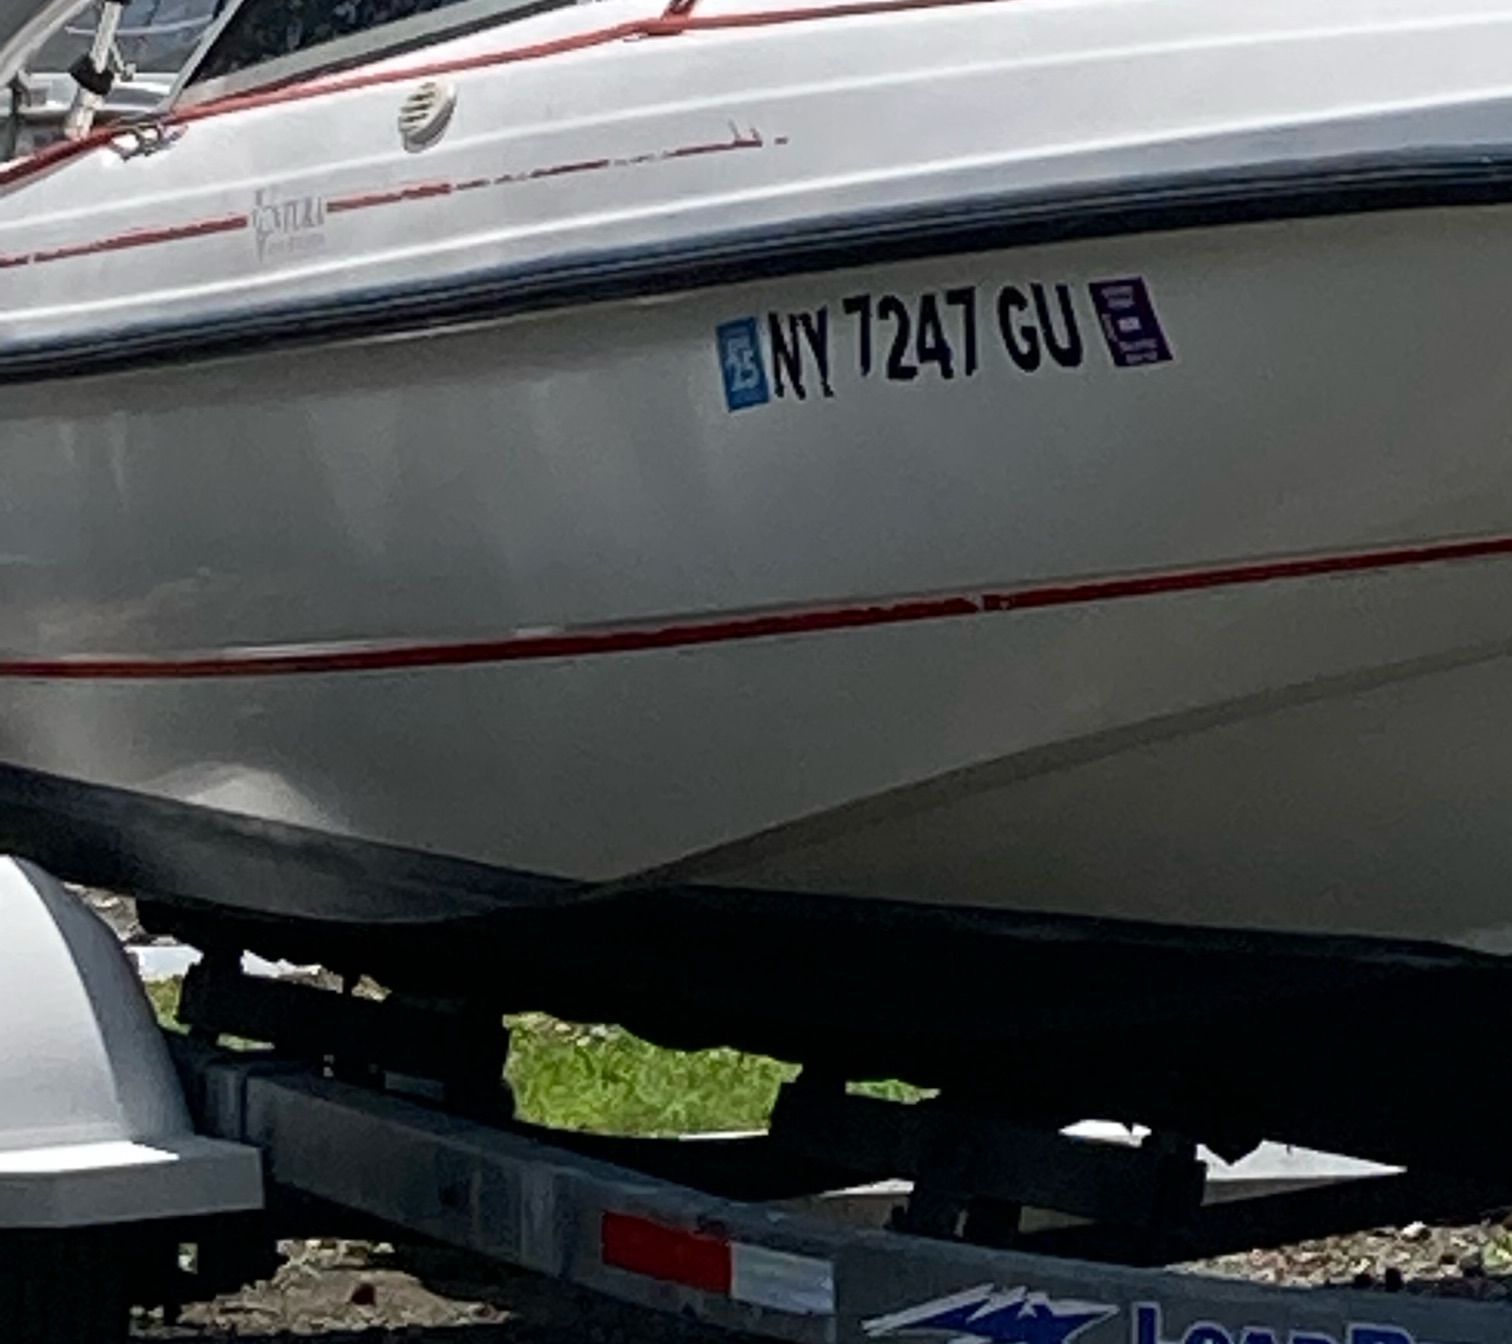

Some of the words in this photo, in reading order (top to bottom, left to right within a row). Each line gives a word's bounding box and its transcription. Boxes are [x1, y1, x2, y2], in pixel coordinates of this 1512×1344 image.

[768, 306, 833, 400] NY
[842, 285, 977, 381] 7247
[998, 282, 1085, 373] GU
